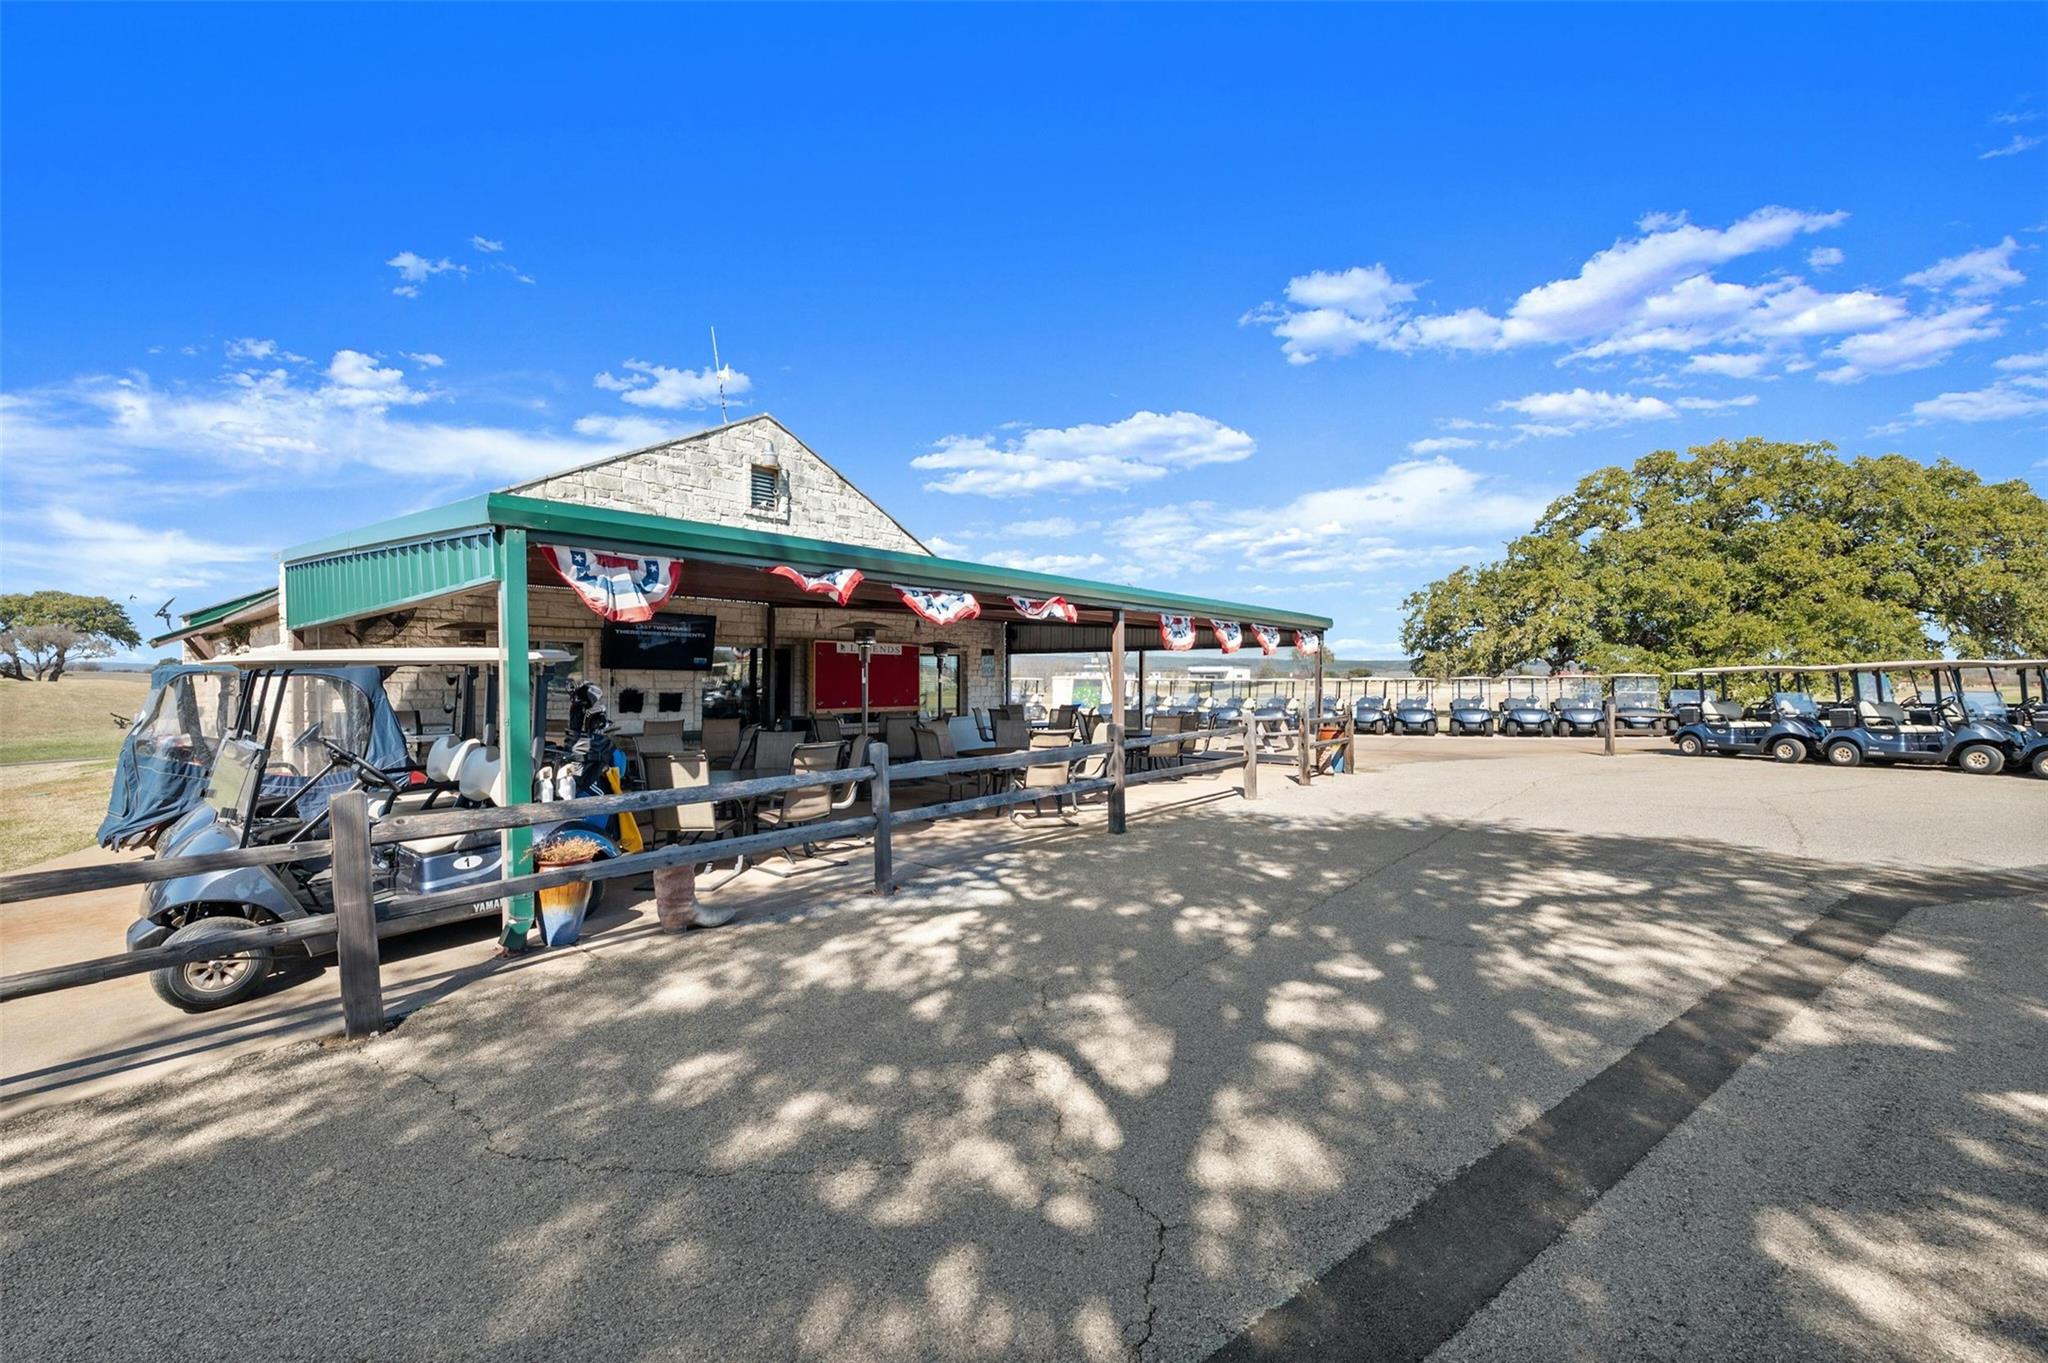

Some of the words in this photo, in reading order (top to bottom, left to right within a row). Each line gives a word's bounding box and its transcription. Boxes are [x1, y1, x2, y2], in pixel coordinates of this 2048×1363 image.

[850, 643, 901, 654] LENDS
[464, 857, 470, 867] 1
[473, 899, 503, 912] YAMA
